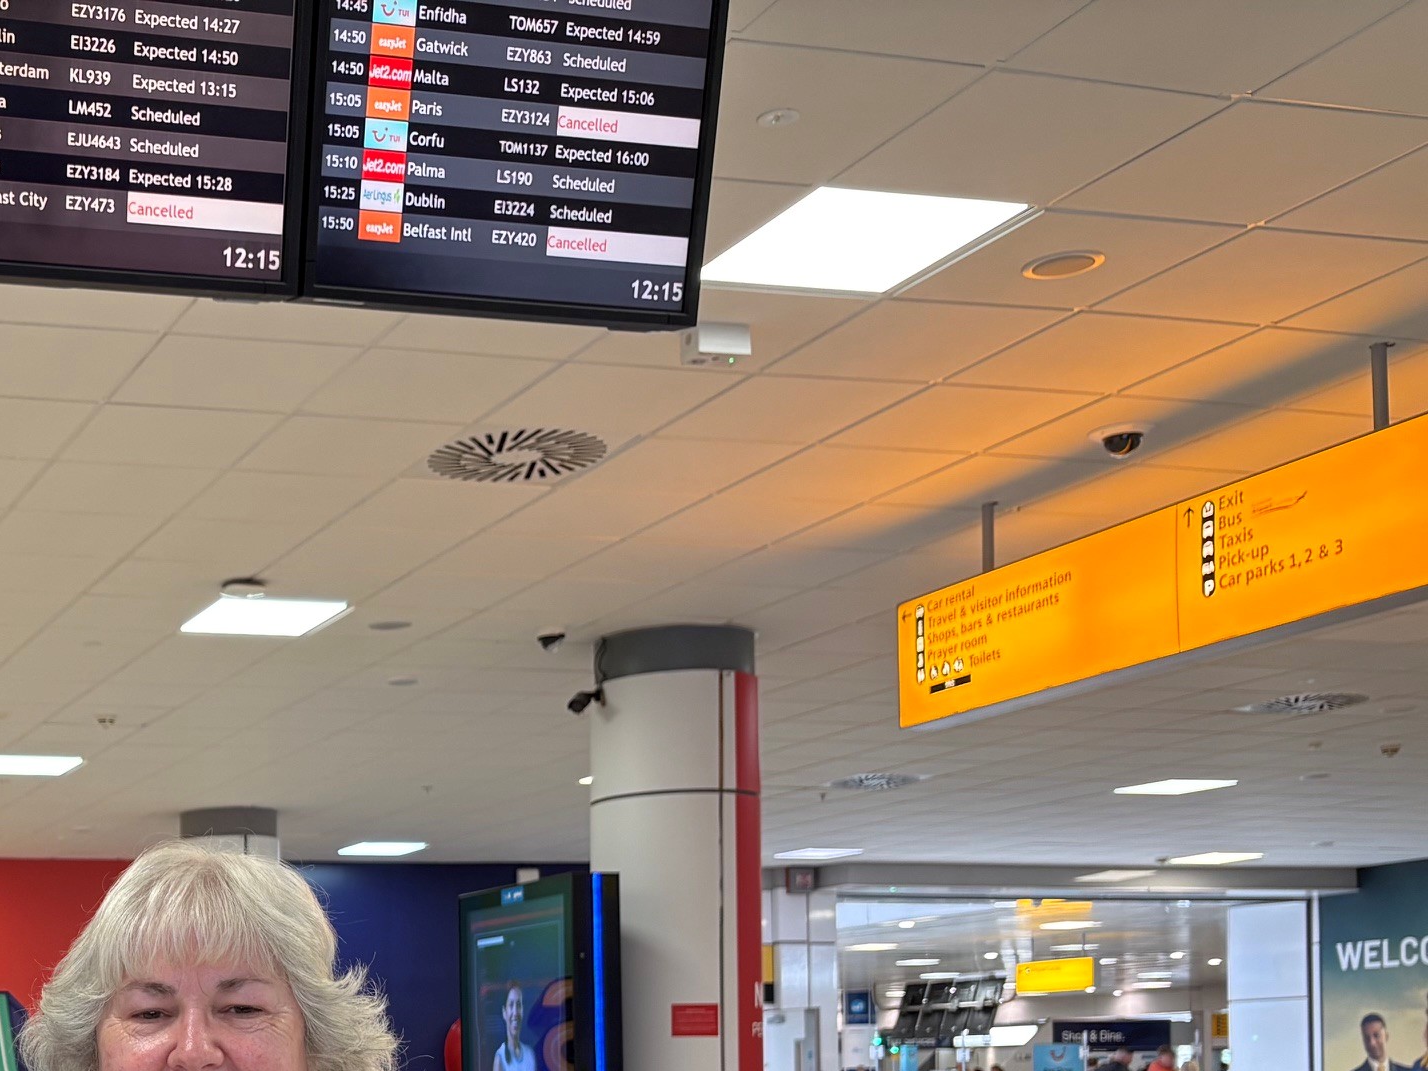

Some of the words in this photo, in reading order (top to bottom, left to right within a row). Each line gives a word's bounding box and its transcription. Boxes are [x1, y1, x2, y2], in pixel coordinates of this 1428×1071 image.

[72, 3, 126, 22] EZY3176
[134, 10, 198, 30] Expected
[203, 17, 240, 34] 14:27
[336, 0, 368, 12] 14:45
[398, 9, 410, 17] TUI
[418, 5, 467, 24] Enfidha
[509, 15, 559, 34] TOM657
[565, 21, 623, 41] Expected
[627, 29, 661, 45] 14:59
[70, 35, 116, 53] EI3226
[133, 42, 197, 62] Expected
[201, 49, 239, 66] 14:50
[333, 29, 366, 44] 14:50
[378, 37, 407, 49] easyJet
[416, 38, 468, 57] Gatwick
[506, 46, 552, 65] EZY863
[562, 52, 627, 72] Scheduled
[69, 68, 111, 85] KL939
[132, 74, 195, 93] Expected
[200, 82, 237, 98] 13:15
[331, 60, 364, 76] 14:50
[413, 69, 450, 86] Malta
[503, 77, 540, 95] LS132
[560, 83, 618, 103] Expected
[622, 90, 655, 106] 15:06
[68, 100, 112, 118] LM452
[131, 106, 201, 126] Scheduled
[329, 92, 362, 108] 15:05
[374, 100, 403, 113] easyJet
[411, 100, 443, 116] Paris
[501, 108, 550, 126] EZY3124
[558, 115, 618, 134] Cancelled
[67, 132, 121, 150] EJU4643
[129, 138, 199, 157] Scheduled
[327, 123, 360, 139] 15:05
[389, 134, 401, 143] TUI
[409, 131, 445, 148] Corfu
[499, 140, 548, 157] TOM1137
[554, 145, 612, 164] Expected
[616, 150, 649, 166] 16:00
[66, 164, 120, 182] EZY3184
[128, 168, 192, 188] Expected
[196, 175, 232, 191] 15:28
[325, 154, 358, 170] 15:10
[407, 162, 446, 179] Palma
[496, 169, 533, 186] LS190
[552, 174, 615, 193] Scheduled
[19, 191, 48, 210] City
[65, 195, 115, 213] EZY473
[128, 201, 194, 219] Cancelled
[323, 185, 356, 200] 15:25
[405, 192, 446, 210] Dublin
[493, 200, 535, 217] EI3224
[549, 204, 612, 224] Scheduled
[321, 215, 354, 230] 15:50
[365, 222, 394, 235] easyJet
[403, 222, 447, 240] Belfast
[450, 226, 472, 242] Intl
[491, 229, 537, 247] EZY420
[547, 235, 607, 253] Cancelled
[222, 246, 280, 270] 12:15
[631, 278, 683, 302] 12:15
[1219, 490, 1244, 510] Exit
[1219, 512, 1242, 530] Bus
[1219, 527, 1254, 550] Taxis
[1219, 544, 1270, 570] Pick-up
[1219, 573, 1241, 589] Car
[1245, 558, 1285, 586] parks
[1289, 554, 1302, 569] 1,
[1305, 549, 1313, 563] 2
[1319, 544, 1329, 558] &
[1335, 539, 1343, 556] 3
[927, 598, 943, 612] Car
[946, 585, 975, 606] rental
[928, 607, 957, 629] Travel
[960, 606, 967, 617] &
[971, 593, 1003, 614] visitor
[1005, 570, 1072, 603] information
[961, 617, 983, 635] bars
[997, 592, 1060, 622] restaurants
[928, 643, 958, 662] Prayer
[961, 634, 988, 649] room
[969, 648, 1001, 669] Toilets
